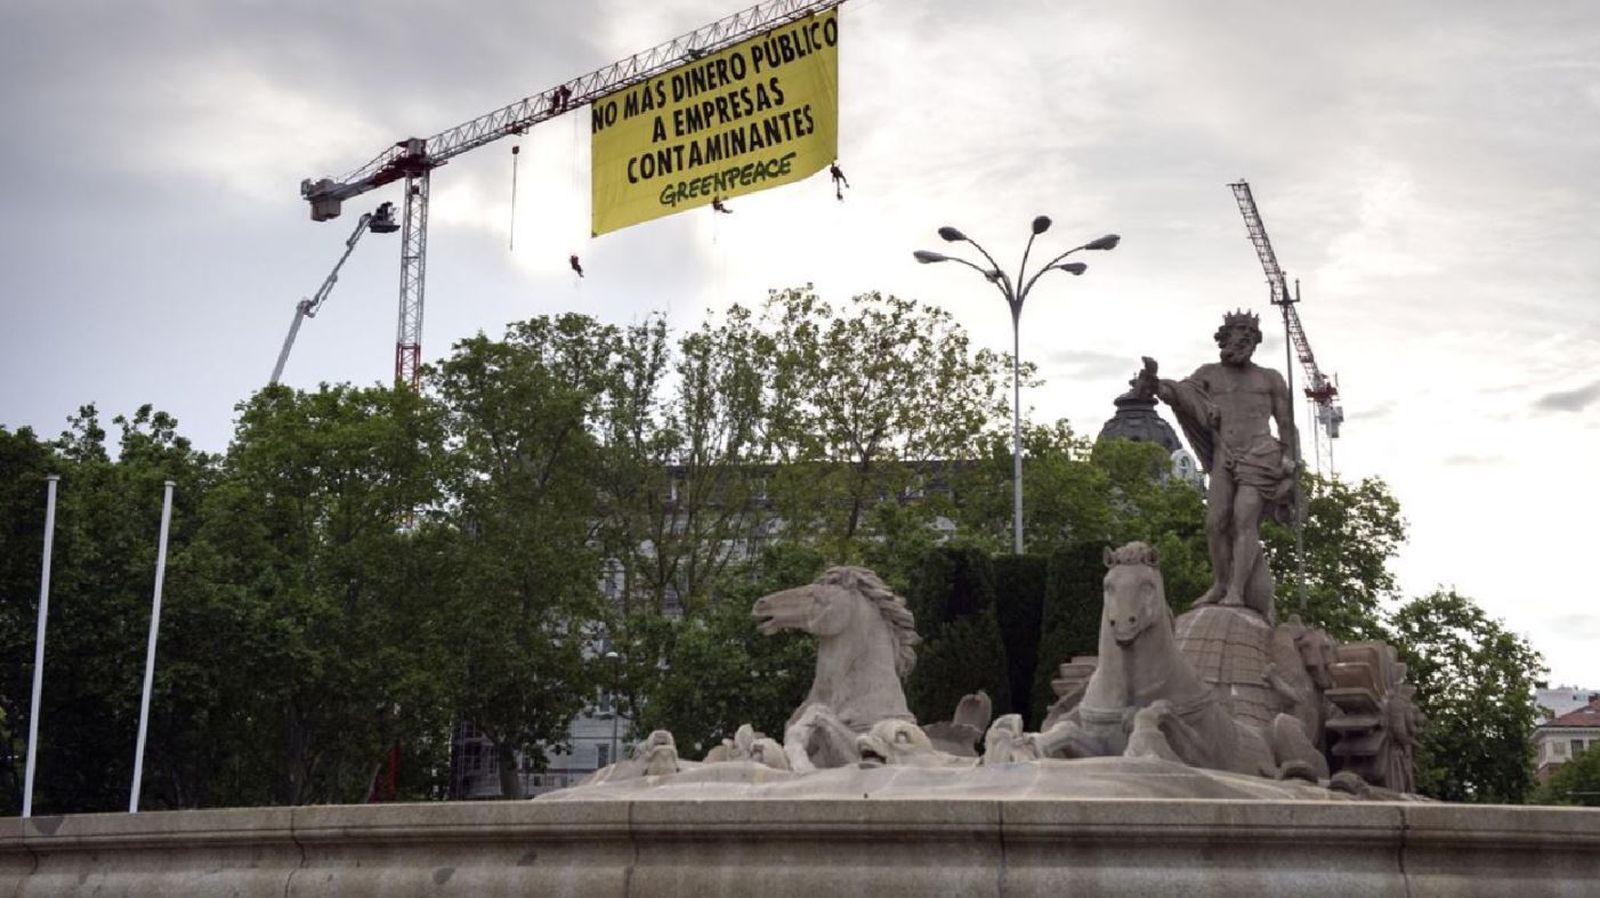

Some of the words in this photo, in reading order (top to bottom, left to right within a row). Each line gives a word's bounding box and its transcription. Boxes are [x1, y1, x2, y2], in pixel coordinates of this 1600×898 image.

[592, 101, 618, 134] NO
[623, 79, 667, 120] MÁS
[671, 52, 747, 107] DINERO
[751, 17, 838, 74] PÚBLICO
[652, 116, 667, 143] A
[675, 77, 784, 137] EMPRESAS
[627, 104, 814, 184] CONTAMINANTES
[659, 152, 796, 207] GREENPEACE
